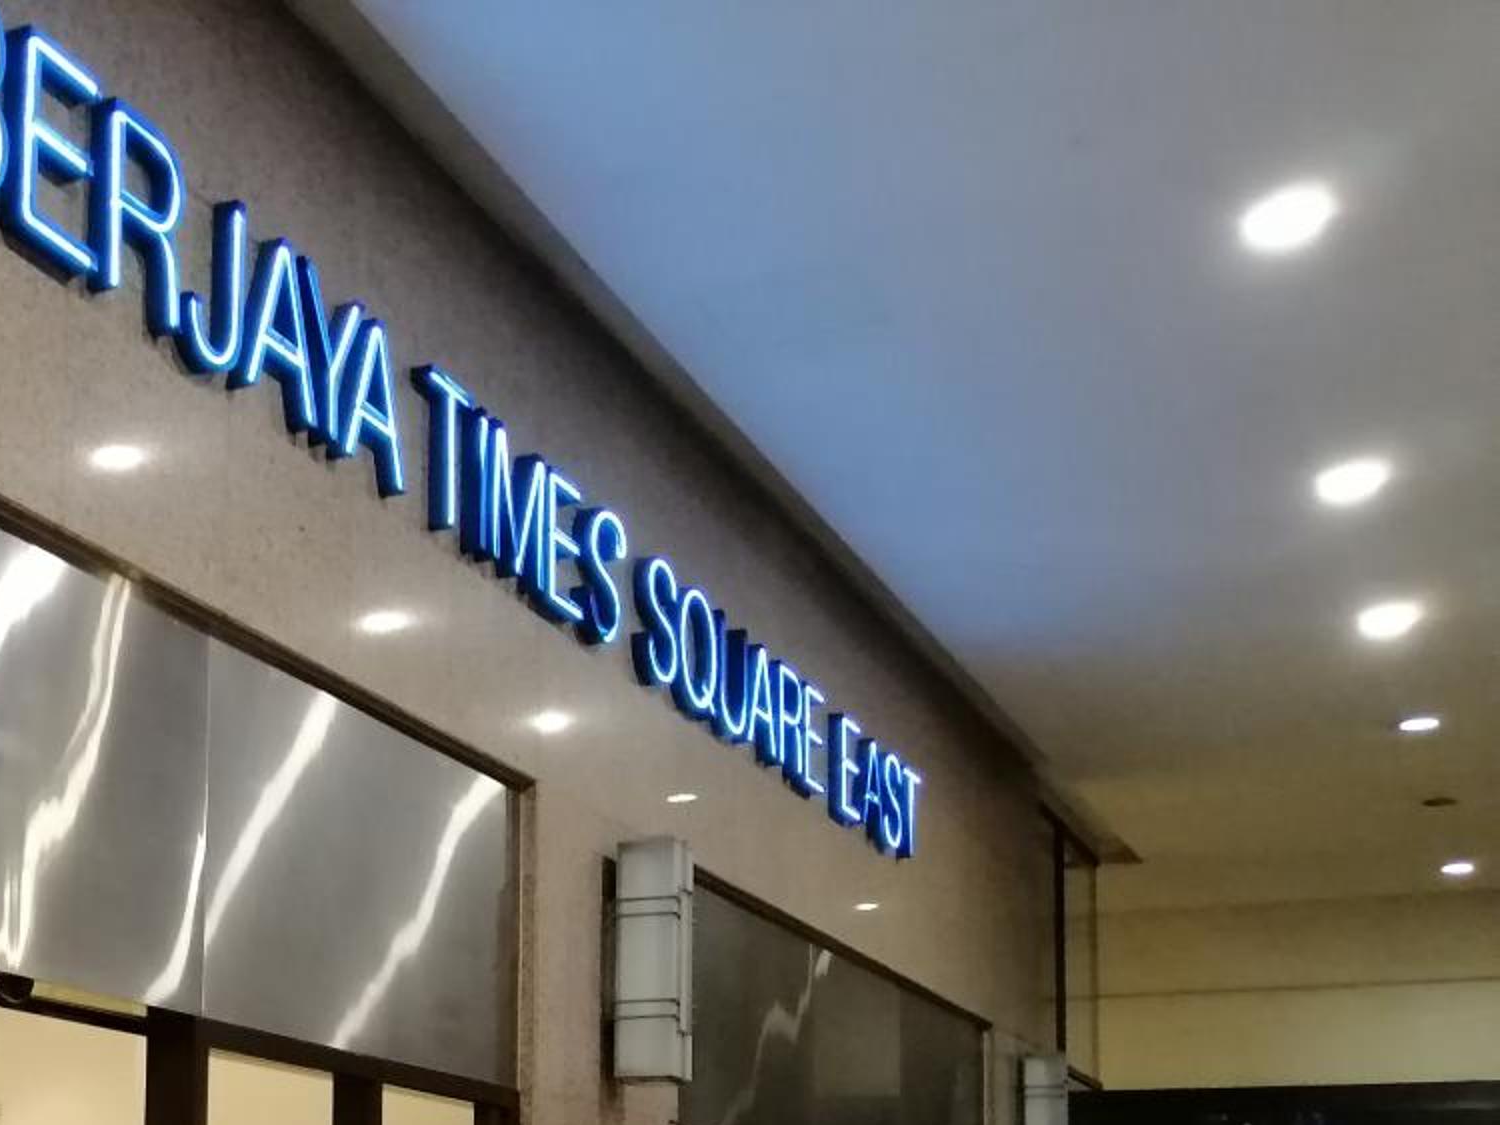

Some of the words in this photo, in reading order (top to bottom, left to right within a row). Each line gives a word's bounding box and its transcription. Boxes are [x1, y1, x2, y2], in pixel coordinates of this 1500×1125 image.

[411, 364, 628, 644] TIMES
[631, 556, 826, 798] SQUARE
[828, 712, 921, 858] EAST
